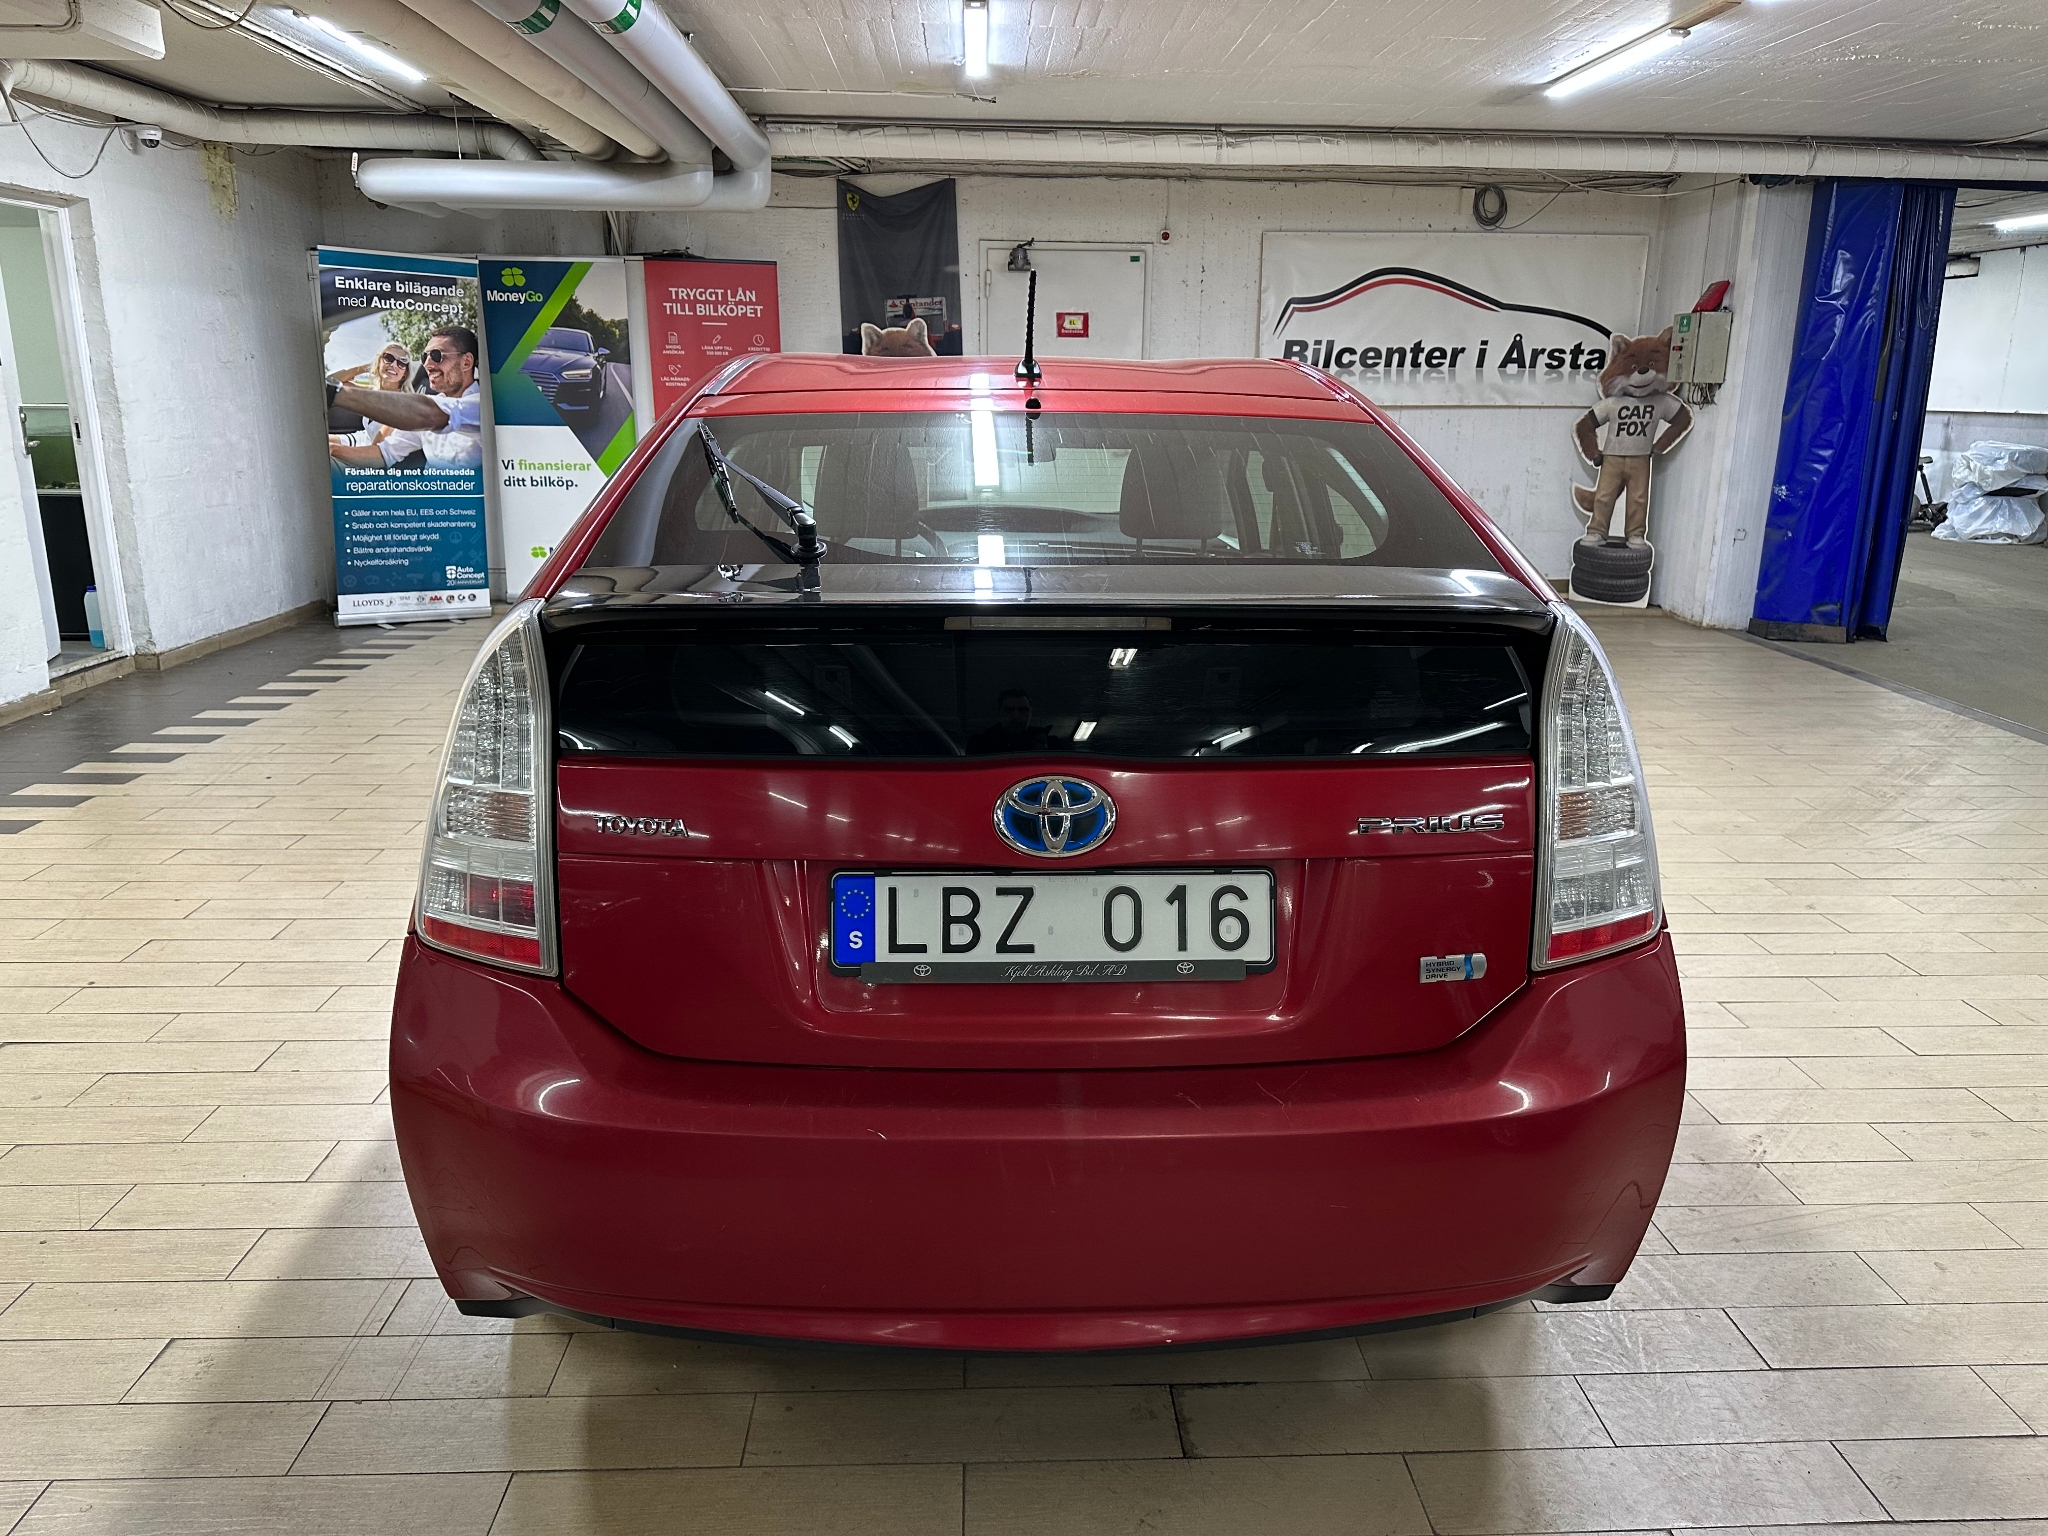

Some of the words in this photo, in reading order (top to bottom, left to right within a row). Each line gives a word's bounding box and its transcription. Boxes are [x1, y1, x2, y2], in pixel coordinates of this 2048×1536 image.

[334, 275, 391, 292] Enklare
[395, 280, 465, 298] bilägande
[668, 287, 724, 301] TRYGGT
[727, 286, 756, 302] LÅN
[338, 296, 367, 308] med
[370, 296, 464, 314] AutoConcept
[486, 289, 544, 305] MoneyGo
[899, 298, 943, 308] Sntander
[662, 302, 694, 316] TILL
[696, 301, 764, 318] BILKÖPET
[1283, 339, 1466, 369] Bilcenter
[1475, 340, 1489, 369] i
[1497, 333, 1607, 370] Årsta
[1617, 404, 1655, 421] CAR
[1616, 421, 1651, 437] FOX
[345, 467, 385, 476] Försäkra
[387, 467, 402, 477] dig
[403, 468, 422, 476] mot
[424, 467, 475, 476] oförutsedda
[501, 459, 515, 471] Vi
[518, 459, 592, 472] finansierar
[346, 479, 476, 494] reparationskostnader
[503, 476, 527, 488] ditt
[530, 476, 578, 491] bilköp.
[351, 509, 371, 517] Gäller
[406, 509, 419, 517] EU,
[449, 508, 476, 516] Schweiz
[351, 521, 375, 530] Snabb
[375, 521, 389, 529] och
[419, 533, 440, 542] skydd
[594, 815, 689, 837] TOYOTA
[1356, 813, 1505, 834] PRIUS
[887, 885, 1036, 954] LBZ
[1101, 884, 1251, 953] 016
[848, 930, 863, 950] S
[1001, 964, 1033, 981] Kjell
[1075, 963, 1100, 976] Bil
[1097, 964, 1128, 976] AB
[1425, 965, 1462, 973] SYNERGY
